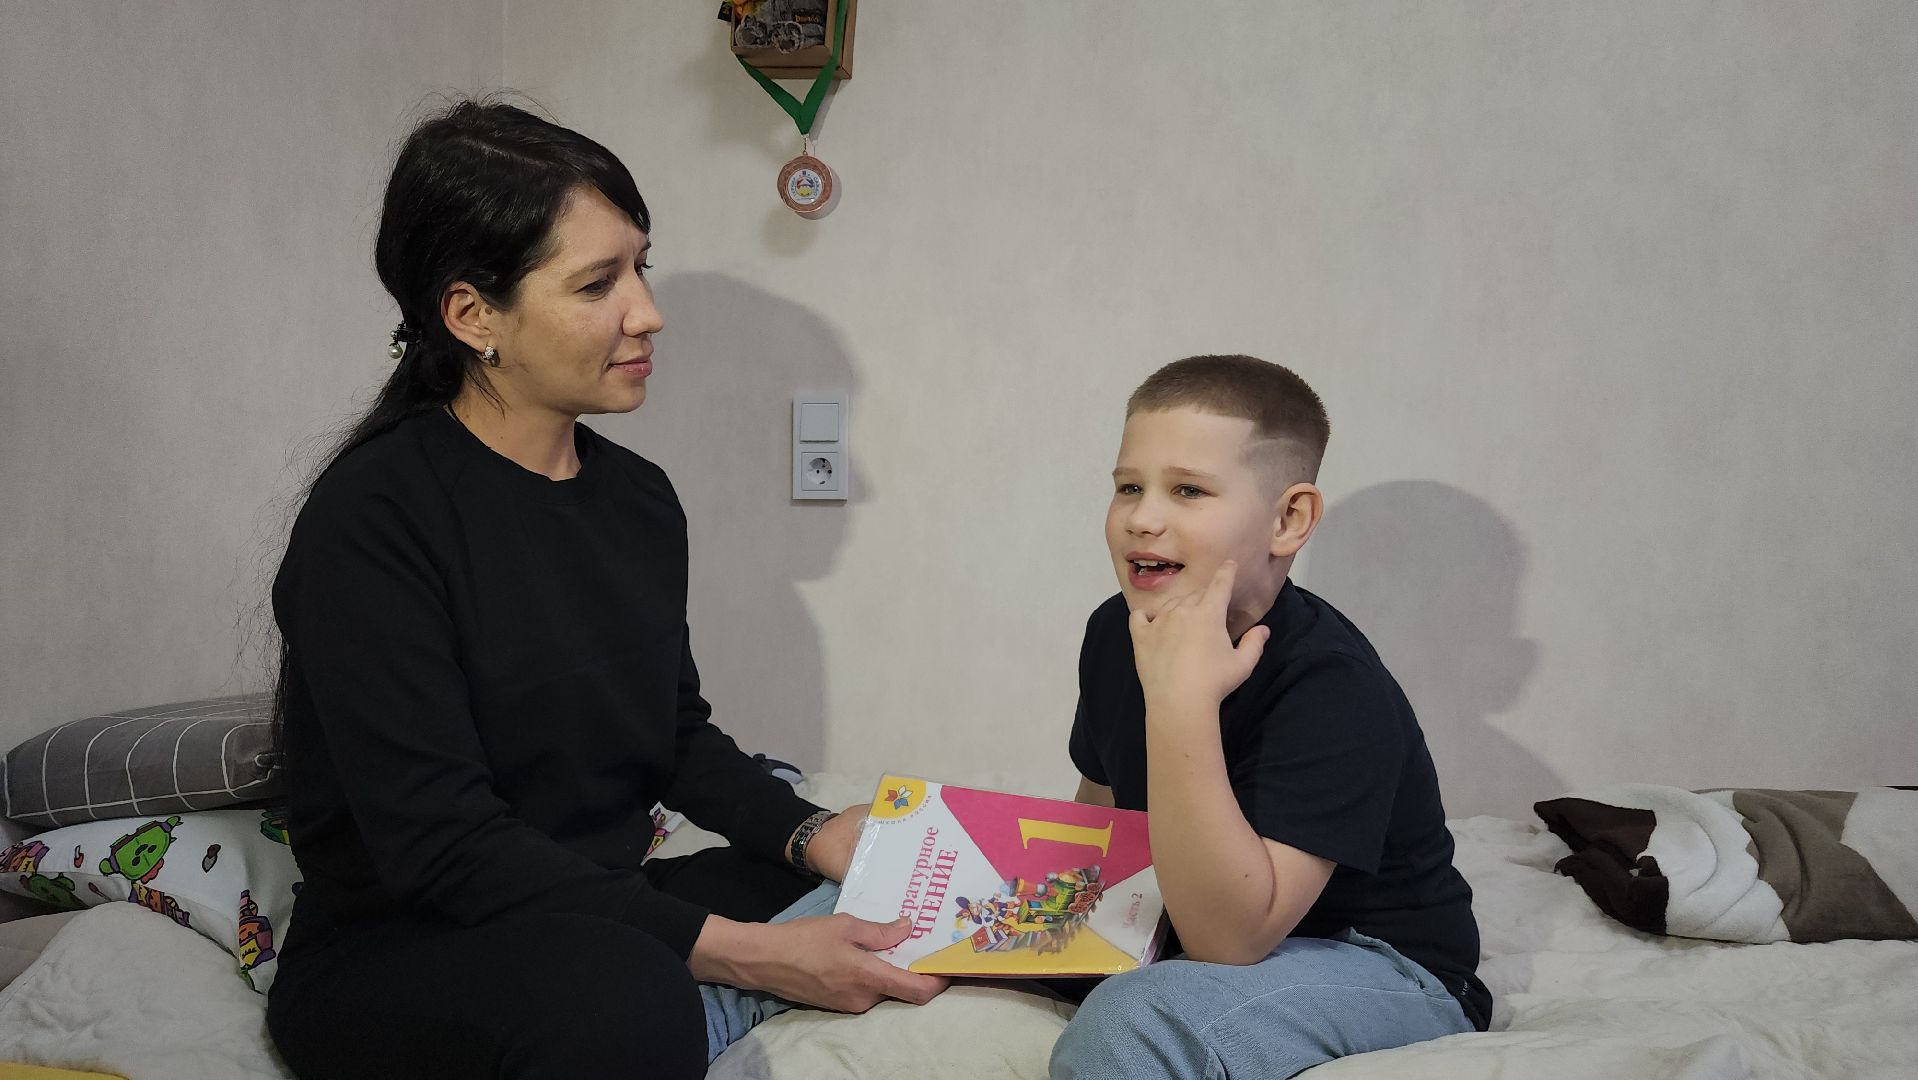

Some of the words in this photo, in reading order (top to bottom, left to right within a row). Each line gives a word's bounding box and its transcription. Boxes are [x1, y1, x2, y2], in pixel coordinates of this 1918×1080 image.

[1017, 817, 1114, 858] 1
[883, 826, 939, 955] ературное
[910, 849, 959, 940] ЧТЕНИЕ
[1131, 892, 1143, 900] 2
